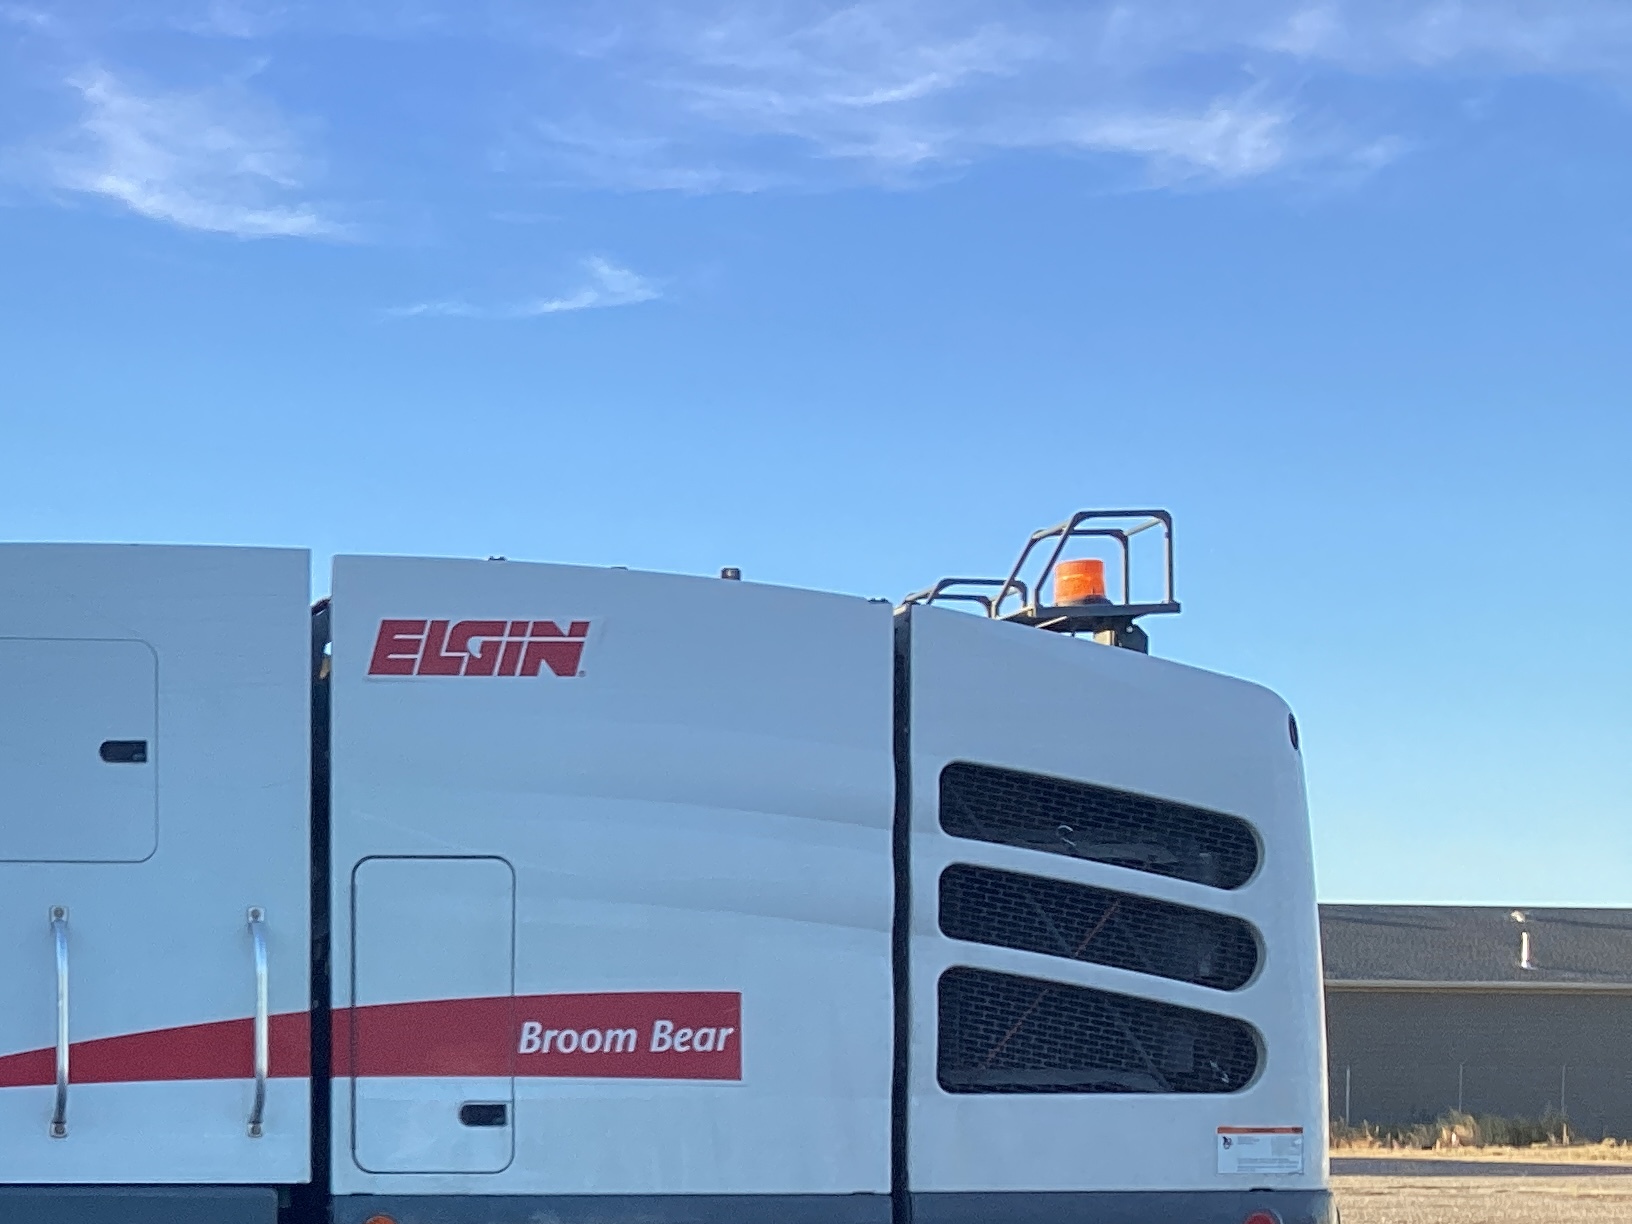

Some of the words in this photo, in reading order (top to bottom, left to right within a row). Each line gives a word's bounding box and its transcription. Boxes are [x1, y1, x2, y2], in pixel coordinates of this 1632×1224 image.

[368, 619, 590, 677] ELGIN
[519, 1021, 637, 1054] Broom
[650, 1020, 734, 1052] Bear
